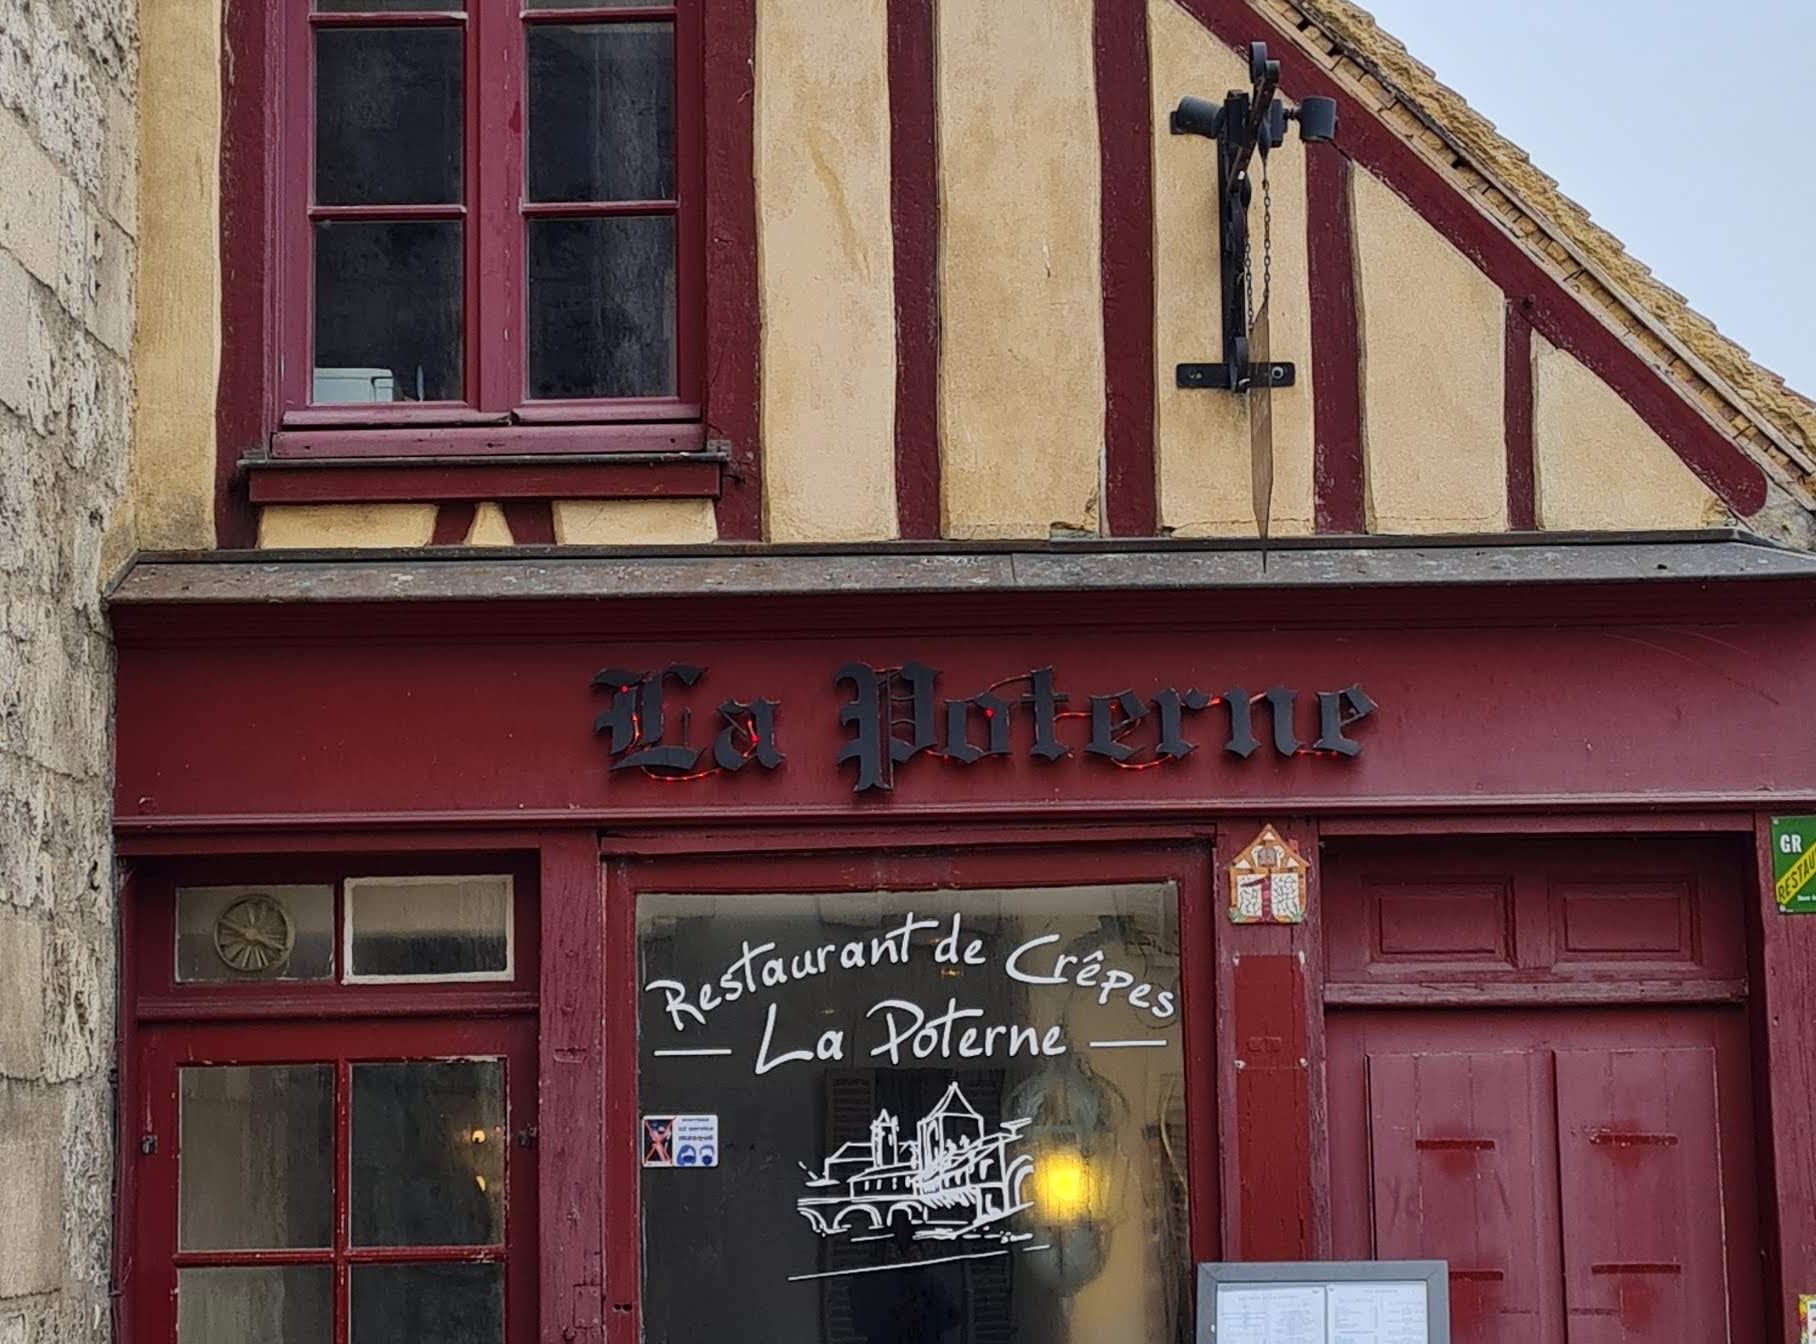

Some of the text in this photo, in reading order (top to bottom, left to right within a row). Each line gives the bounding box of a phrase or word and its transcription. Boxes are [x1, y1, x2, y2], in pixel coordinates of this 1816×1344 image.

[592, 662, 1377, 792] La Poterne
[1778, 847, 1816, 900] RESTAU
[1780, 834, 1802, 853] GR
[645, 912, 1175, 1031] Restaurant de Crêpes
[755, 998, 1067, 1074] La Poterne
